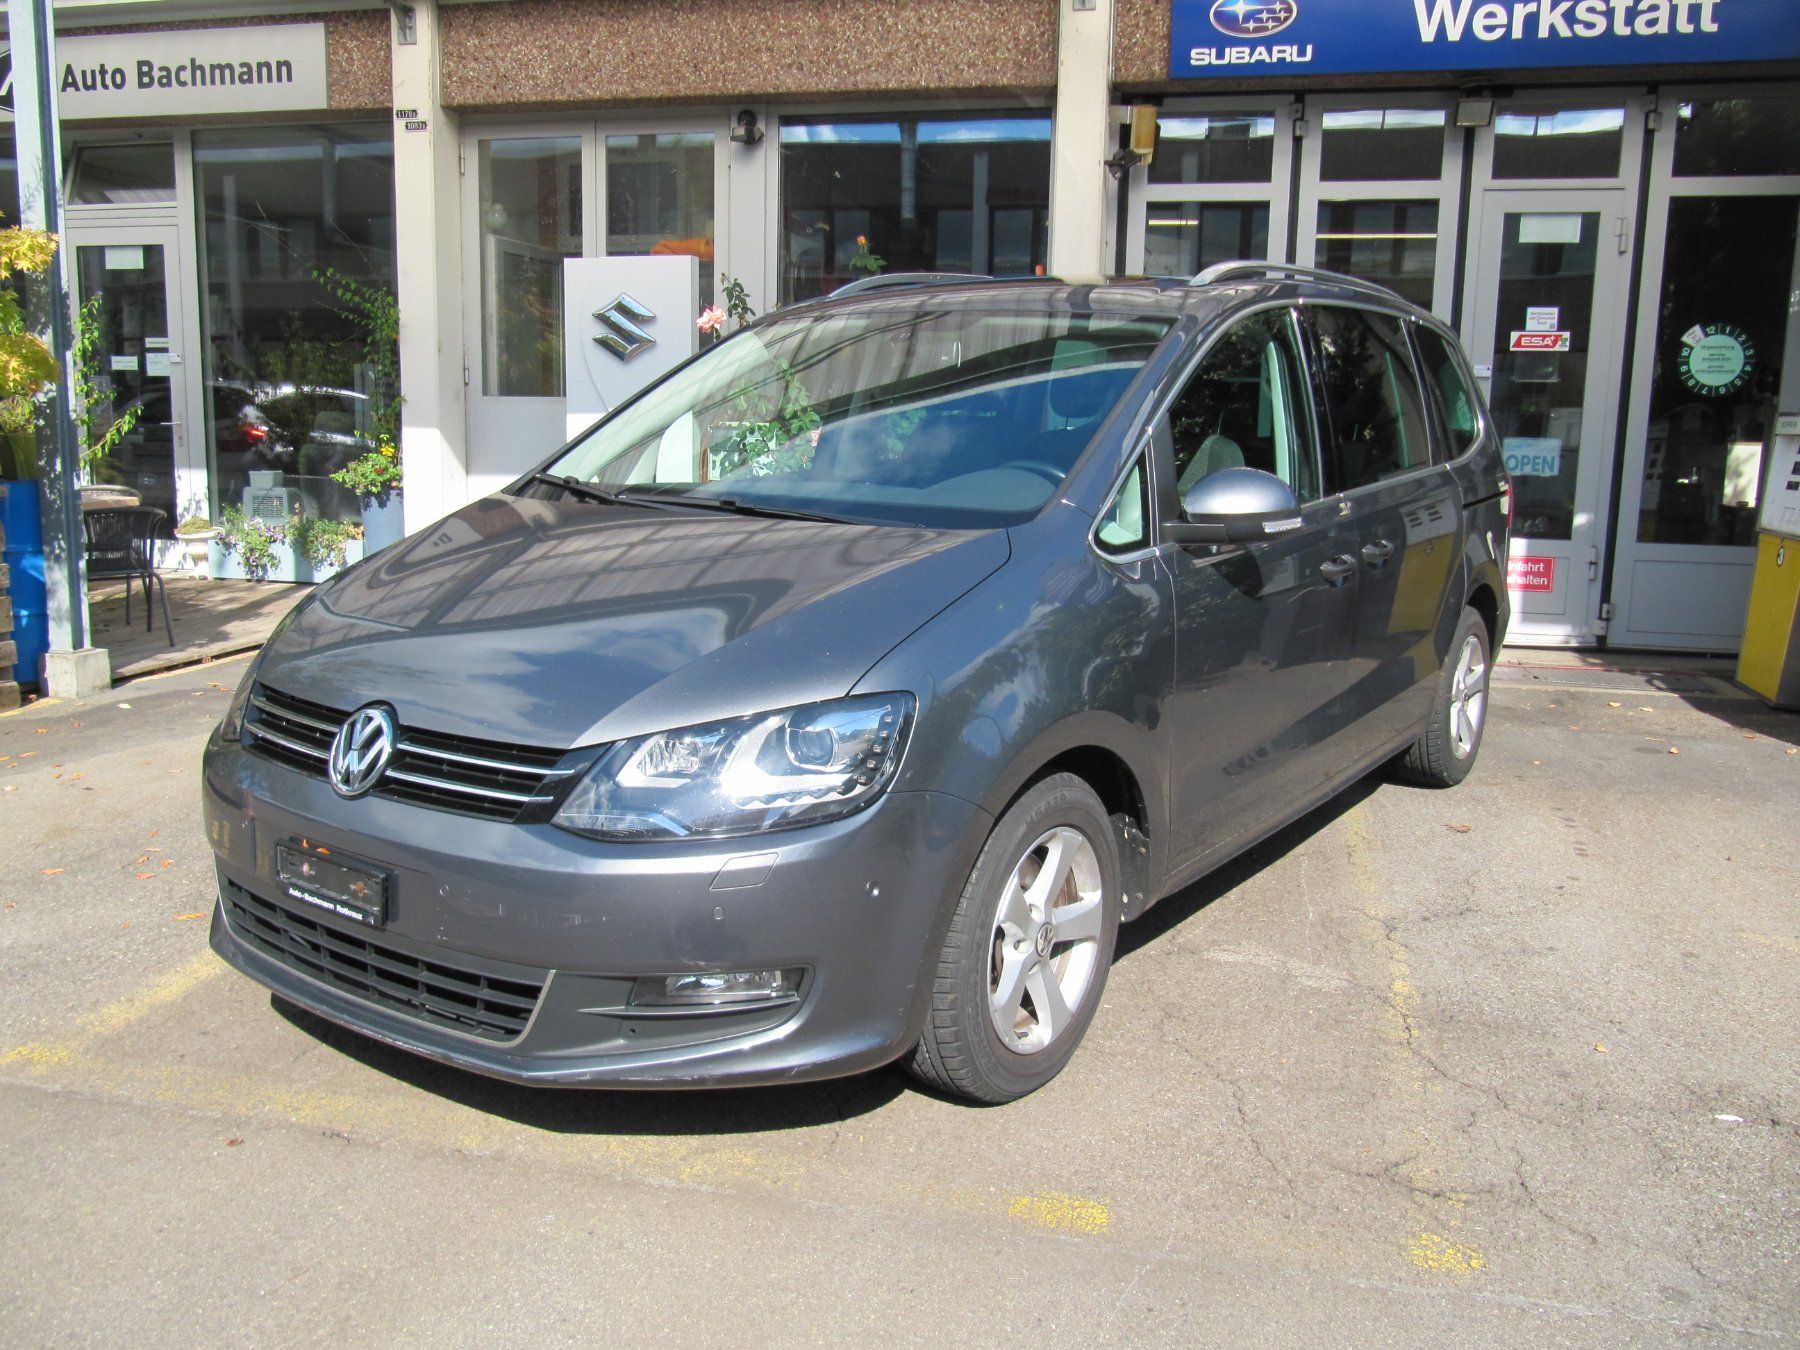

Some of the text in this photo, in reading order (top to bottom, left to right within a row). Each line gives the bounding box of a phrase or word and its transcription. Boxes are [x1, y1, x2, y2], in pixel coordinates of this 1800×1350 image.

[1413, 0, 1721, 43] Werkstatt
[1190, 45, 1312, 67] SUBARU
[61, 57, 293, 92] Auto Bachmann
[1705, 326, 1716, 335] 12
[1725, 326, 1731, 334] 1
[1737, 334, 1746, 343] 2
[1505, 454, 1555, 473] OPEN
[1777, 547, 1784, 565] 3
[1508, 561, 1545, 571] infahrt
